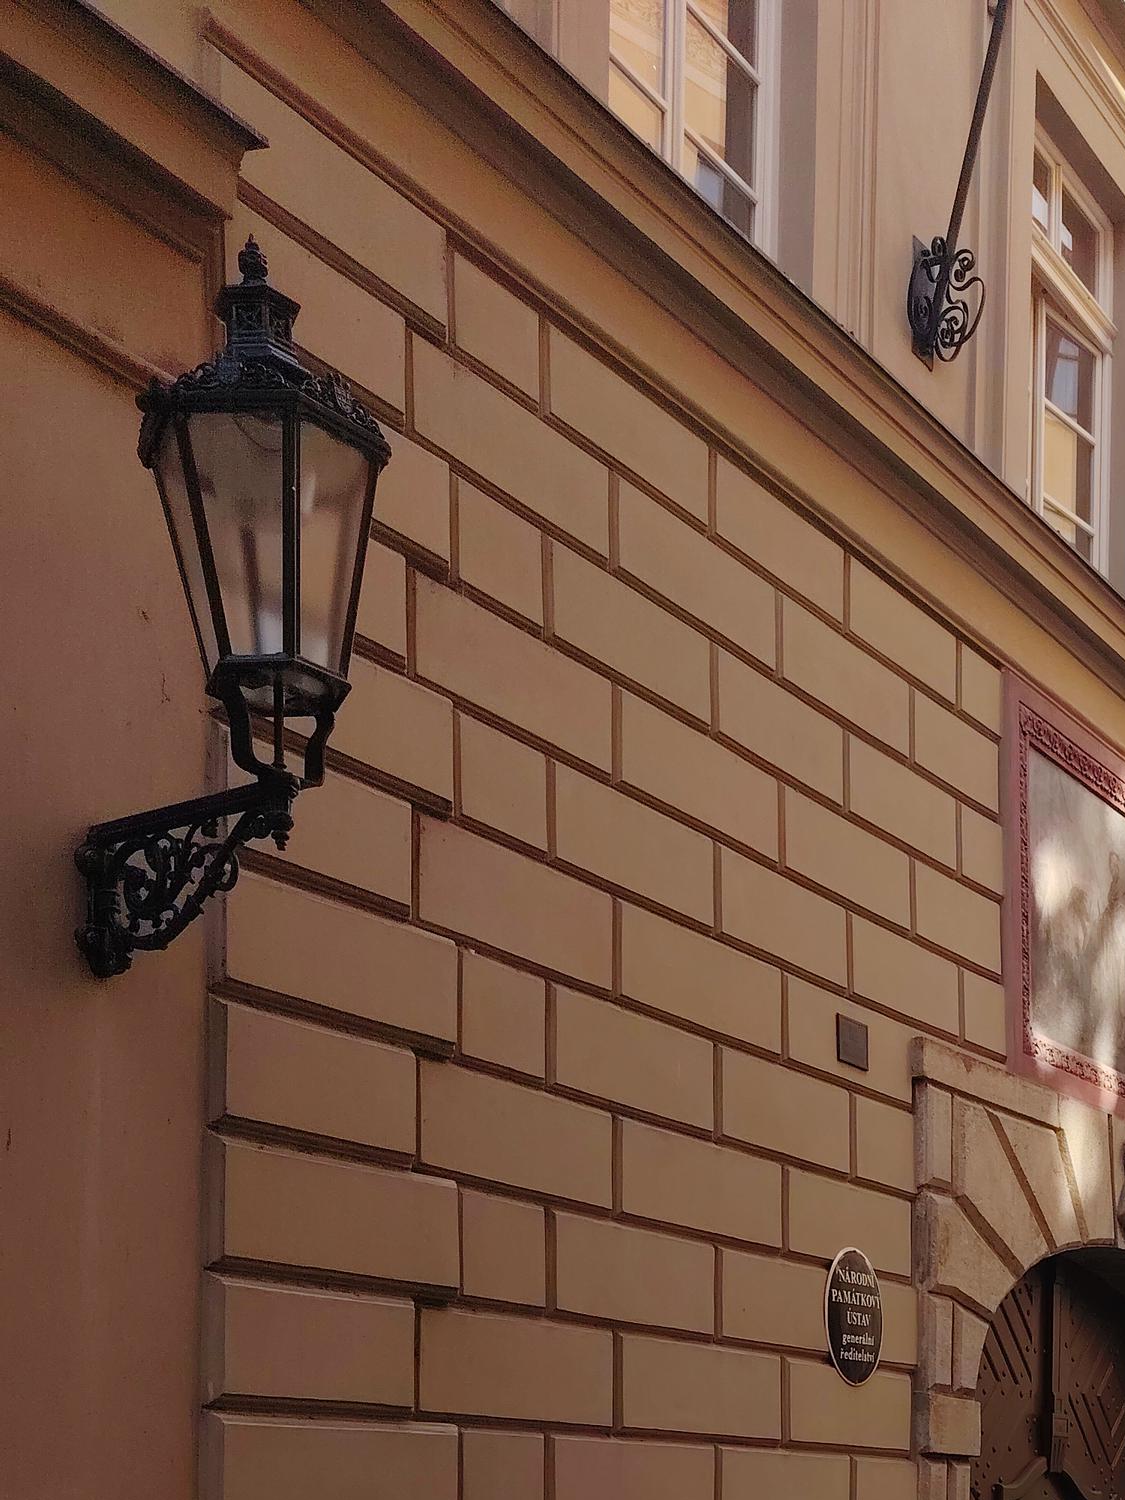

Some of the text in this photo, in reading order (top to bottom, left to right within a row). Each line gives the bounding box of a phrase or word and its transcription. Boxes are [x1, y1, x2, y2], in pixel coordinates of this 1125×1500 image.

[838, 1266, 875, 1288] NÁRODNÍ
[831, 1288, 880, 1309] PAMÁTKOVÝ
[847, 1308, 871, 1327] ÚSTAV
[842, 1332, 875, 1346] generální
[840, 1347, 875, 1363] ředitelství
